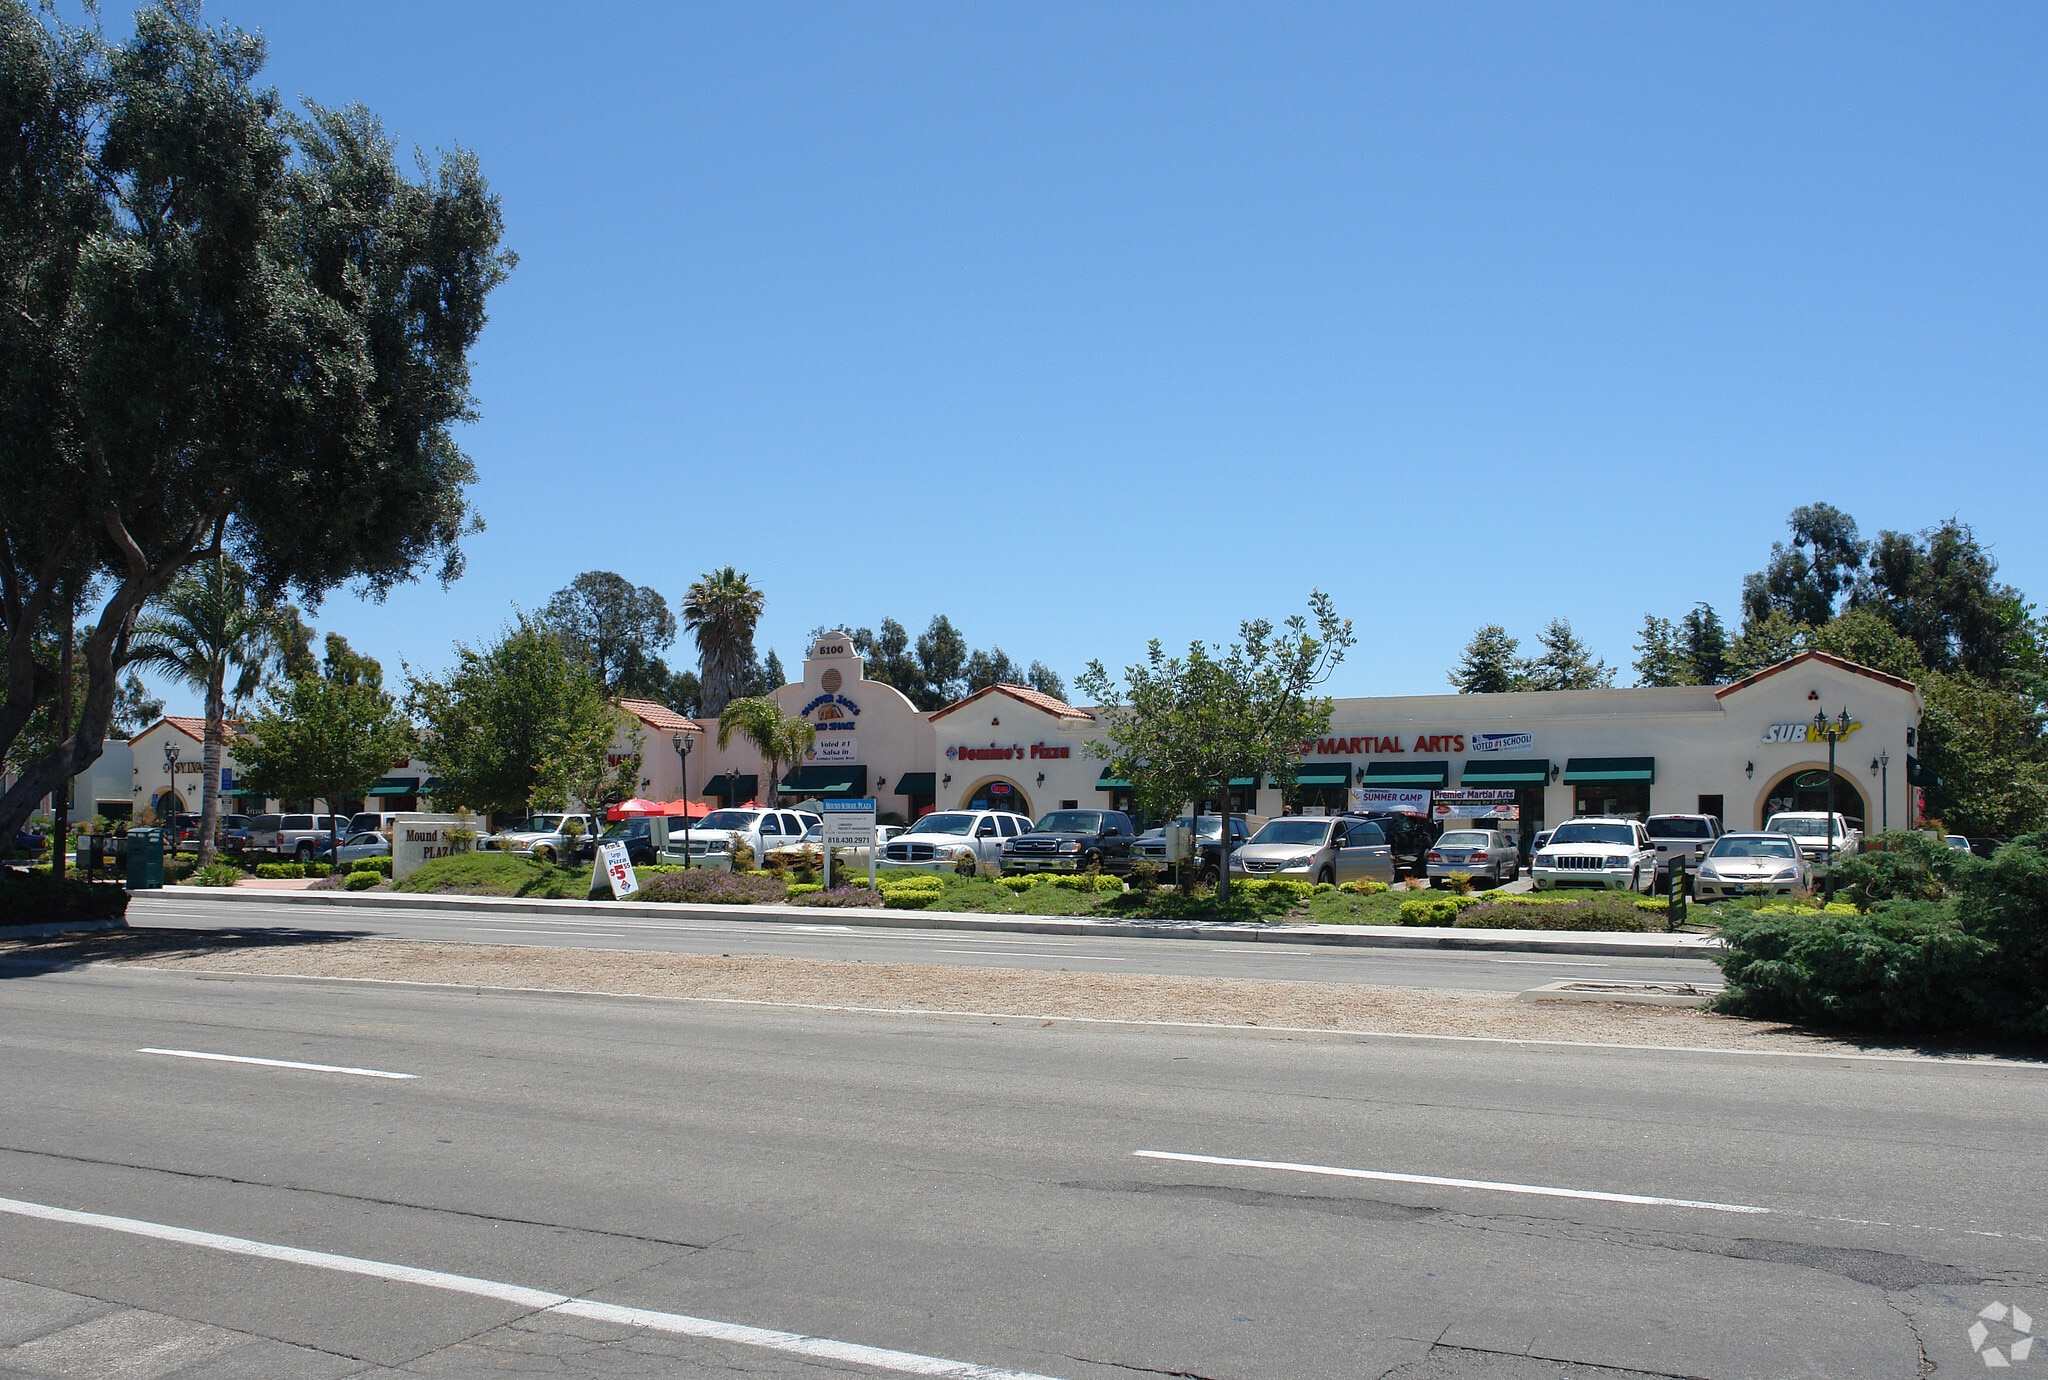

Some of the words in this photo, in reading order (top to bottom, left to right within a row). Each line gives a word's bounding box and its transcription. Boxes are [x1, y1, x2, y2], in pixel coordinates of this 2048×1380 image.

[820, 646, 844, 655] 5100
[1317, 737, 1404, 754] MARTIAL
[1413, 735, 1465, 752] ARTS
[1472, 742, 1493, 751] VOTED
[1503, 735, 1532, 747] SCHOOL!
[958, 742, 1024, 760] Domino's
[1030, 741, 1069, 759] Pizza
[174, 762, 204, 773] SYLVA
[1363, 793, 1397, 801] SUMMER
[1434, 790, 1464, 799] Premier
[1467, 791, 1495, 799] Martial
[1497, 790, 1514, 798] Arts
[406, 830, 438, 842] Mound
[424, 847, 455, 859] PLAZA
[609, 858, 627, 866] Pizza
